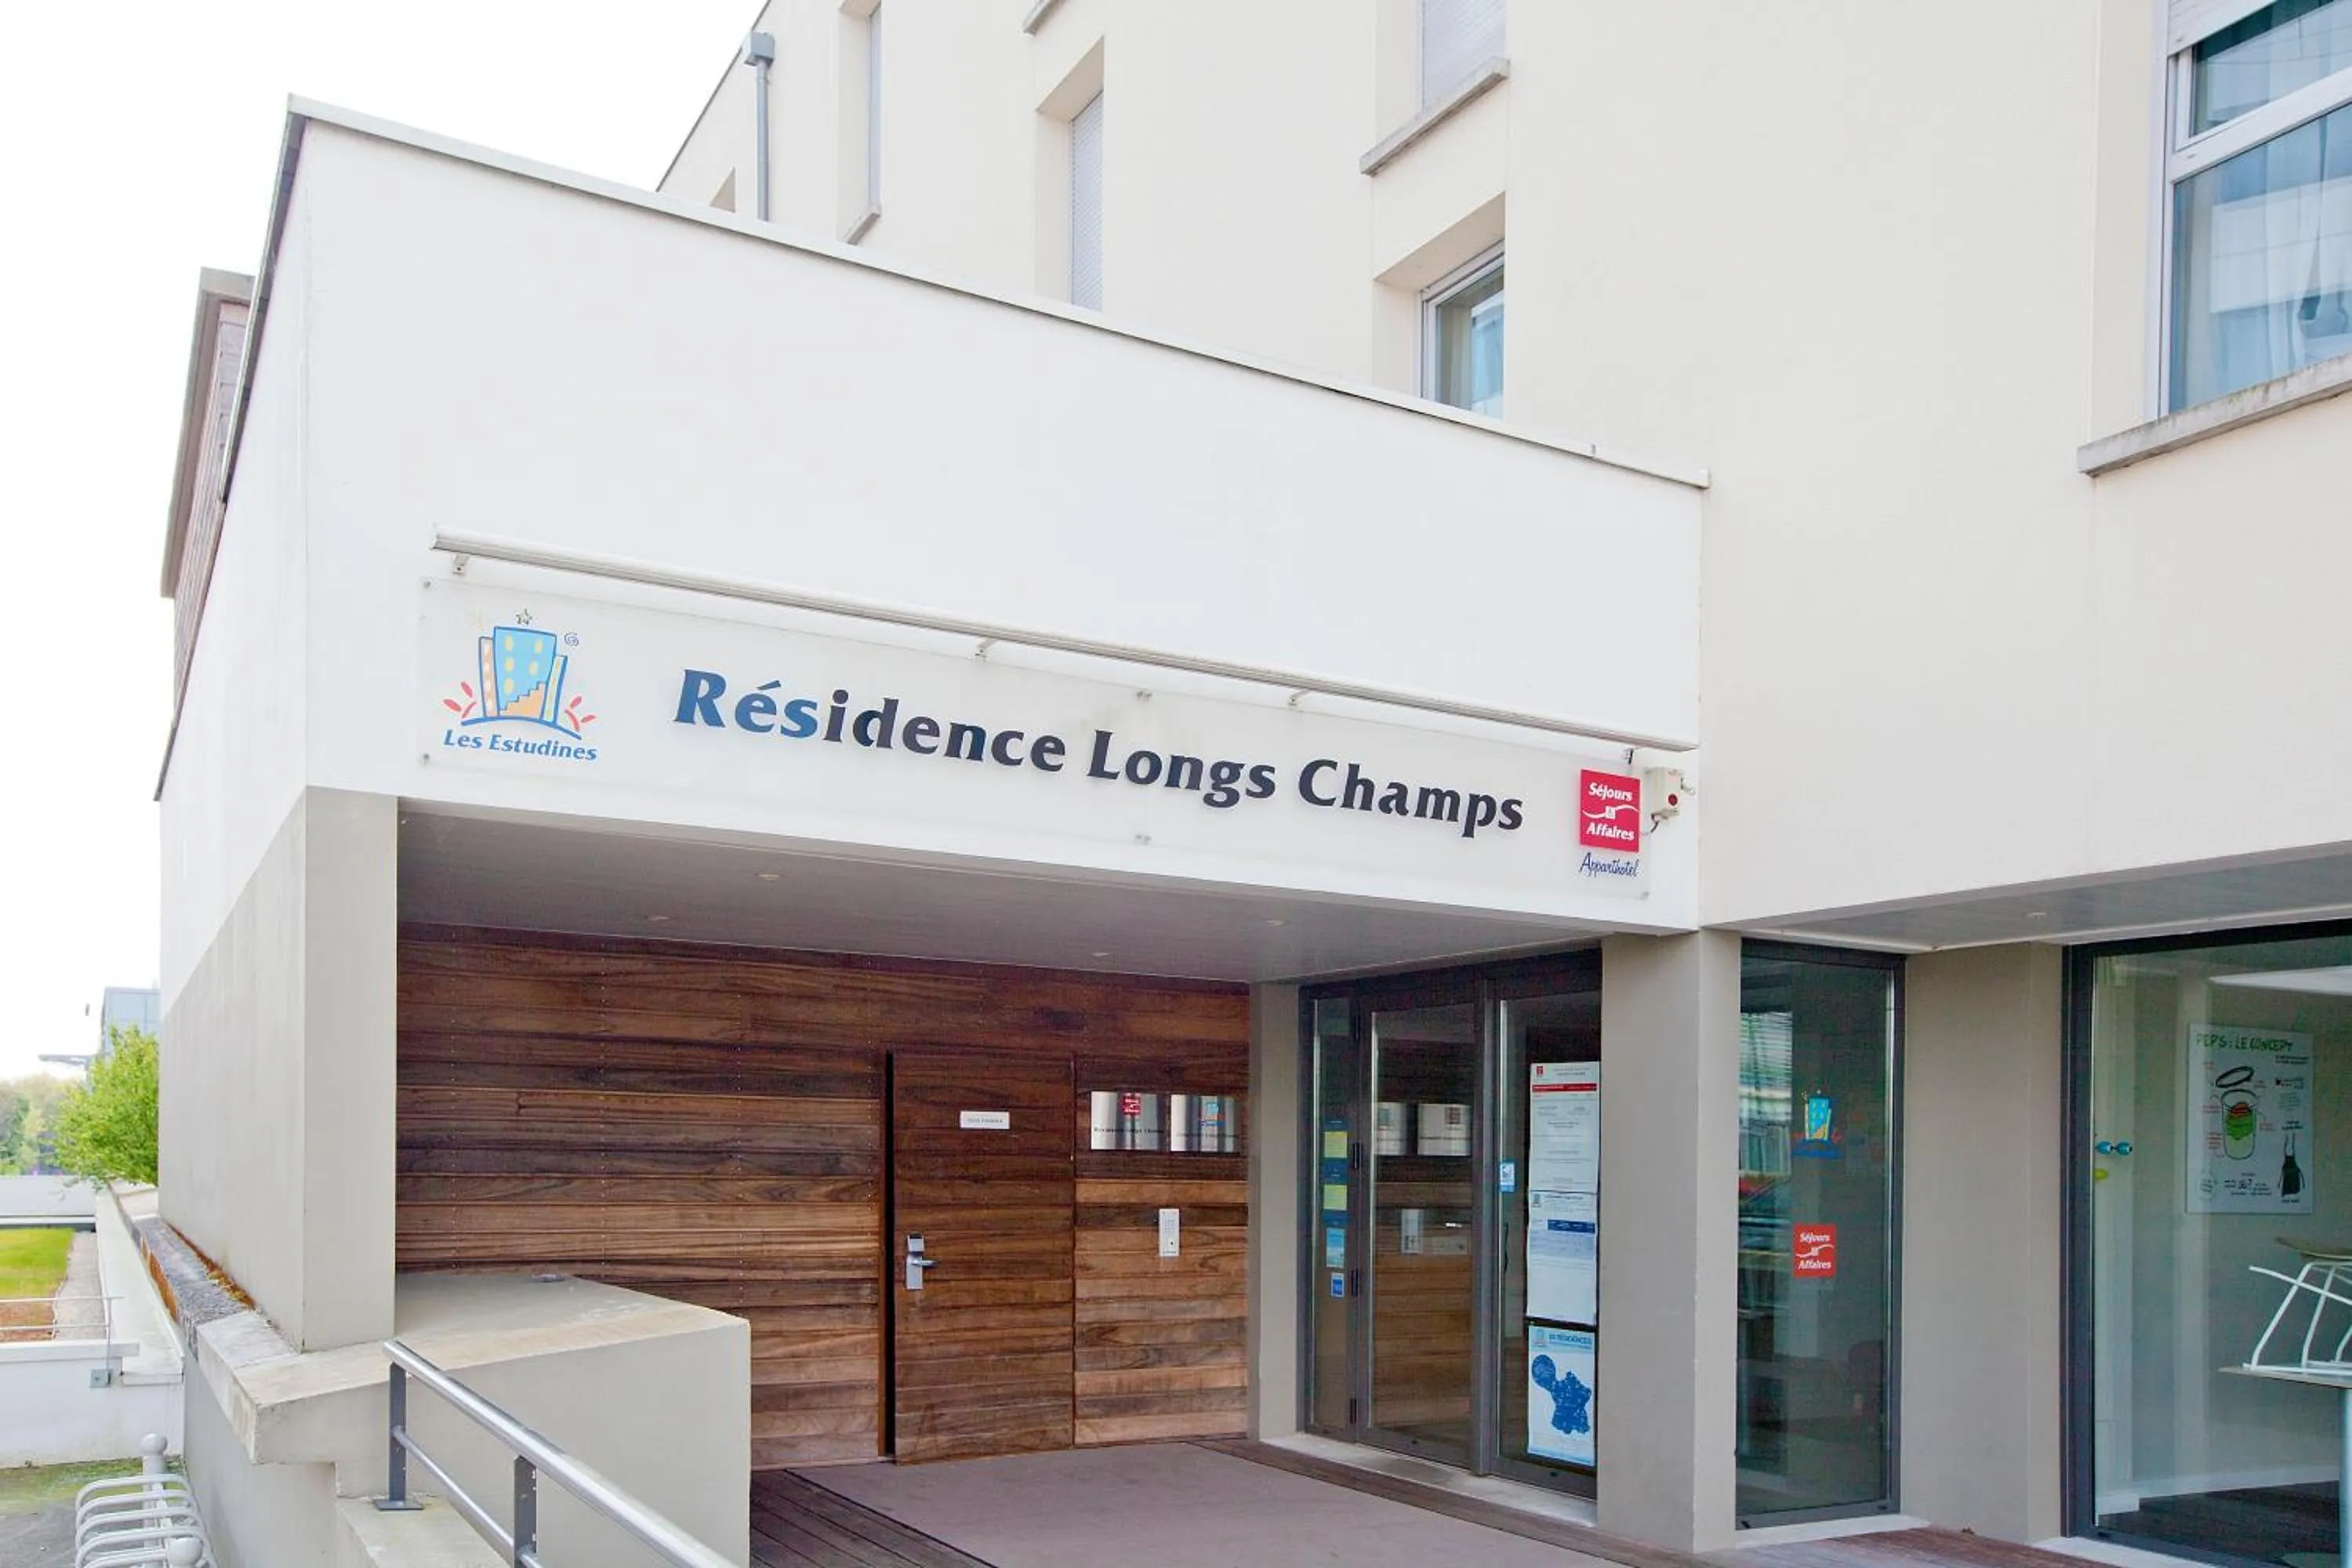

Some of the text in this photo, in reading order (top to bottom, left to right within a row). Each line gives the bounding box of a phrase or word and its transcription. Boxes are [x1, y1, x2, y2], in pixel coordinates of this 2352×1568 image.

[443, 728, 597, 761] Les Estudines
[673, 669, 1524, 838] Résidence Longs Champs
[1588, 781, 1633, 801] Séjours
[1586, 822, 1635, 841] Affaires
[1799, 1232, 1831, 1244] Séjours
[1798, 1259, 1831, 1270] Affaires
